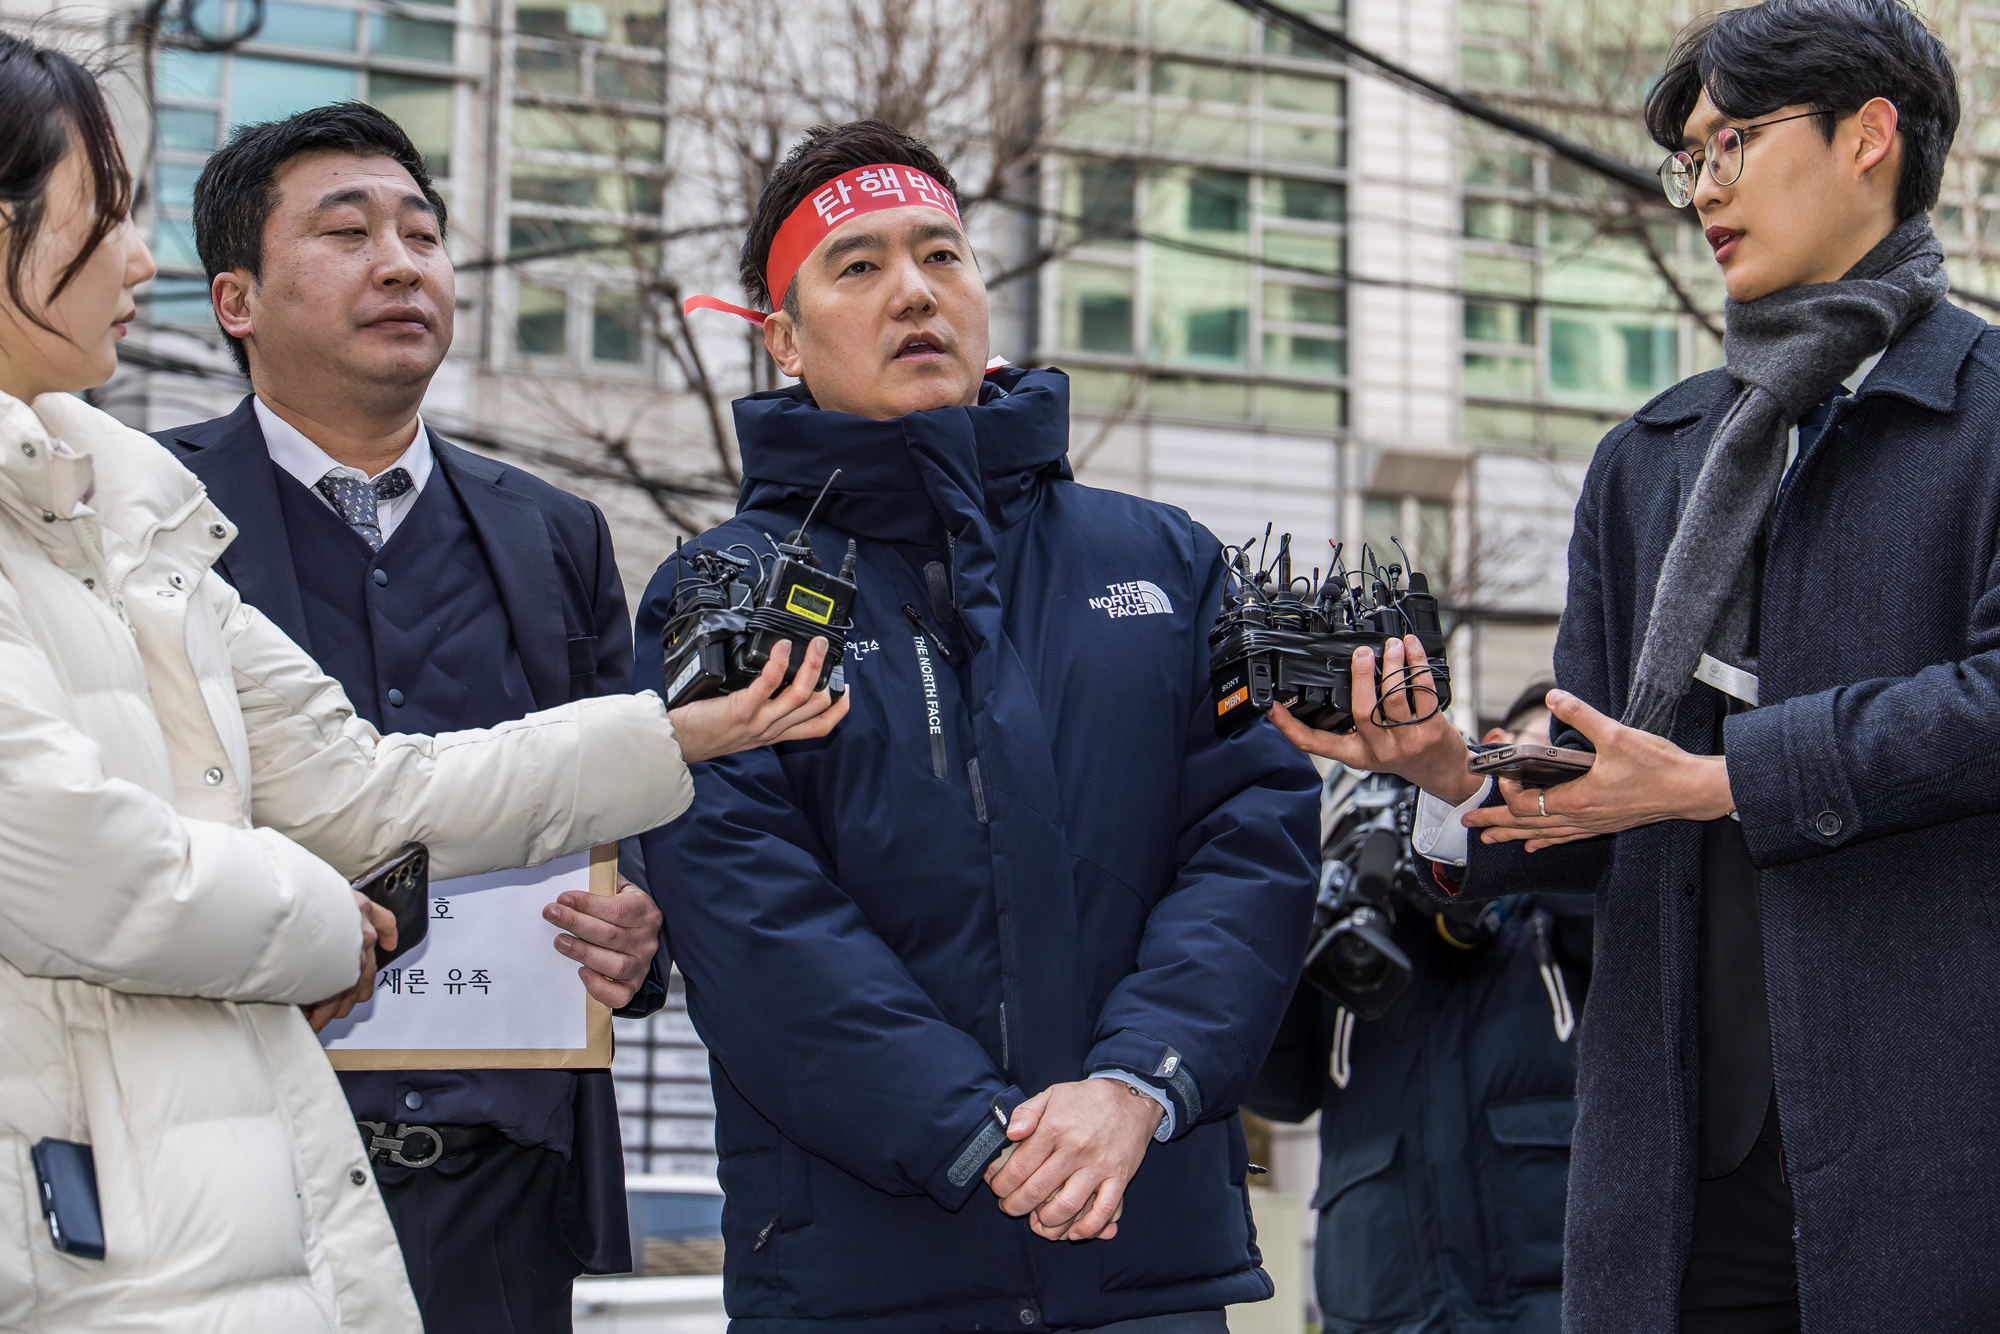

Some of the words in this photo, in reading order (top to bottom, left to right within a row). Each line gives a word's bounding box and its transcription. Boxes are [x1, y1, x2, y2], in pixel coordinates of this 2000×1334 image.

[1106, 582, 1139, 595] THE
[1088, 593, 1144, 609] NORTH
[1107, 603, 1147, 618] FACE
[843, 639, 880, 660] 연구소
[914, 635, 928, 655] THE
[920, 657, 937, 698] NORTH
[1221, 676, 1240, 692] SONY
[1224, 692, 1241, 711] MBN
[927, 701, 941, 735] FACE
[430, 897, 454, 919] 호
[378, 968, 429, 995] 새론
[443, 968, 492, 995] 유족
